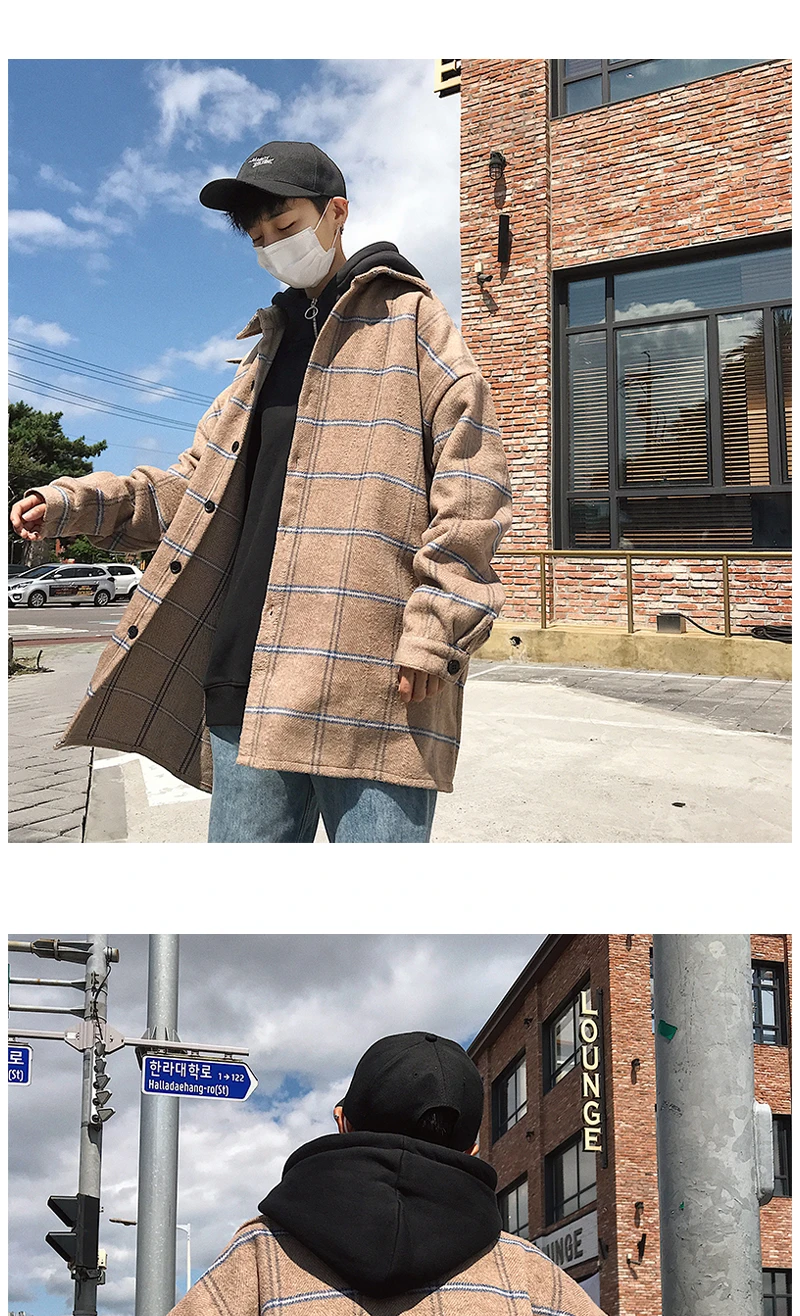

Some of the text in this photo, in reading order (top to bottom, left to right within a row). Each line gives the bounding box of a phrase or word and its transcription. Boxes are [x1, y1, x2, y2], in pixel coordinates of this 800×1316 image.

[8, 1069, 24, 1082] (St)
[149, 1060, 212, 1081] 한라대학로
[580, 990, 602, 1151] LOUNGE
[148, 1079, 229, 1097] Halladaehang-ro(St)
[543, 1227, 584, 1266] UNGE
